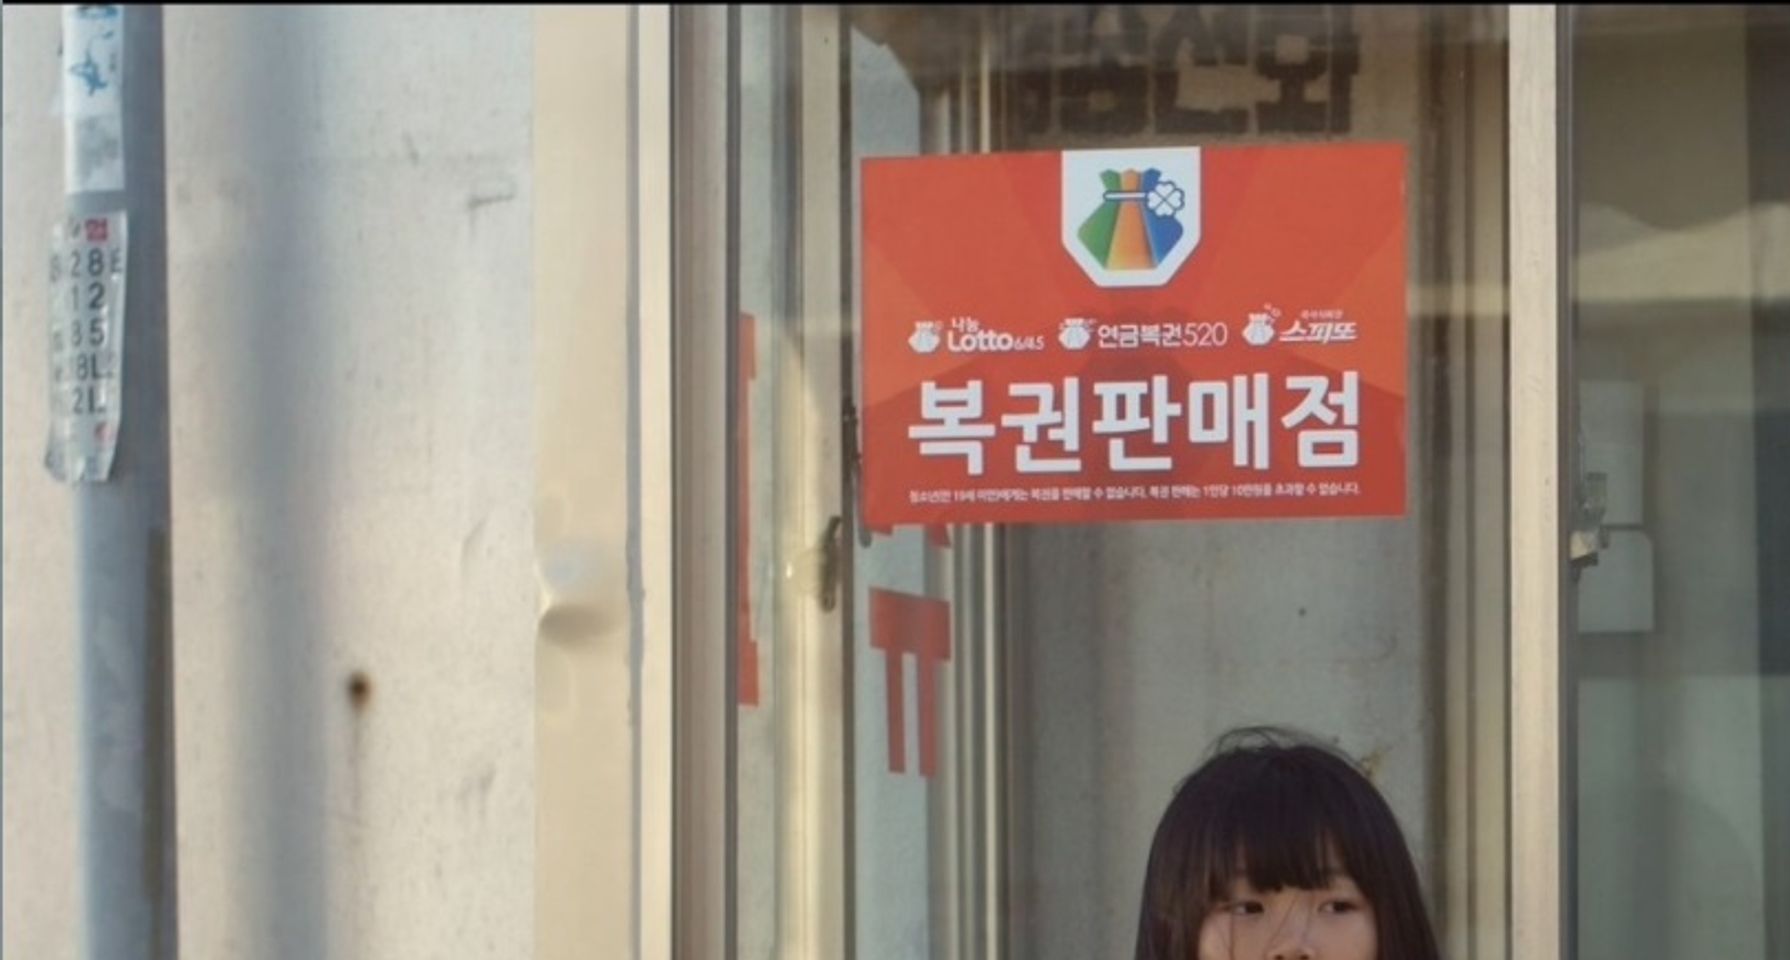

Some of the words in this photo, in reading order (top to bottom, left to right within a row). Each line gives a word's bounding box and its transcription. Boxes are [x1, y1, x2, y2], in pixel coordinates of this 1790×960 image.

[1097, 321, 1229, 348] 연금복권520
[1278, 319, 1359, 345] 스피또
[907, 370, 1360, 477] 복권판매점
